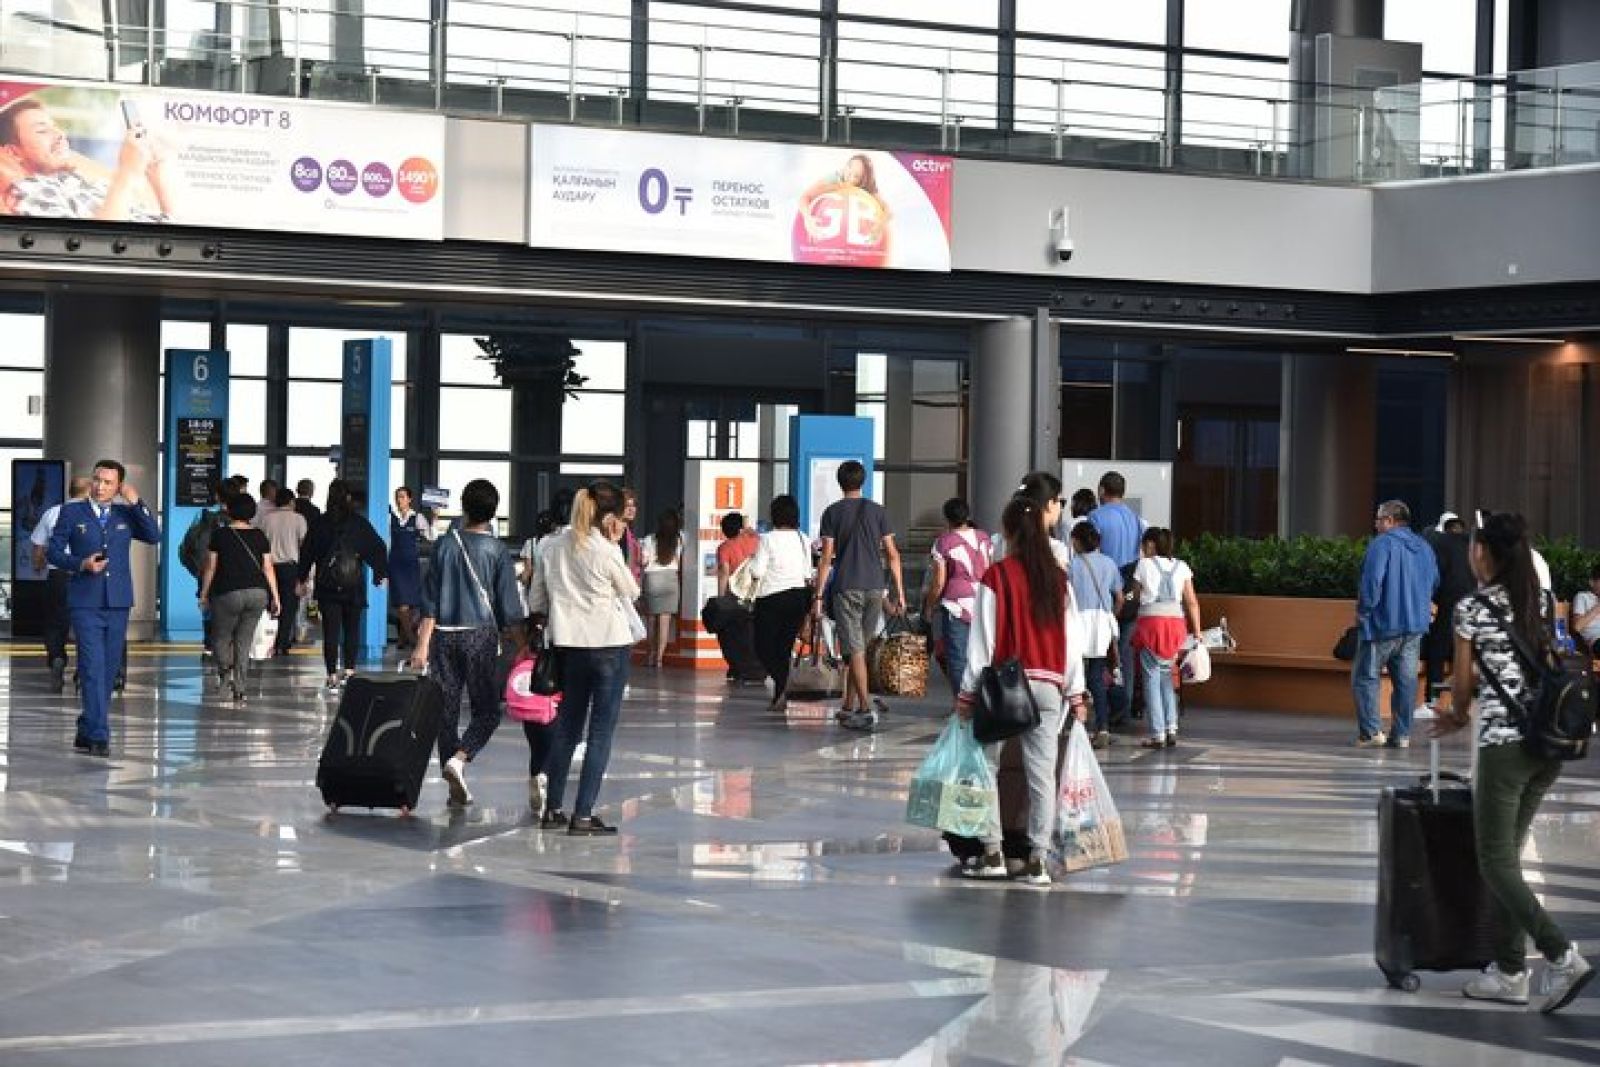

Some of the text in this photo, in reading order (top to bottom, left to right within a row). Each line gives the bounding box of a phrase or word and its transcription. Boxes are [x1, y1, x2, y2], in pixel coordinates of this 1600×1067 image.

[164, 102, 291, 129] КОМФОРТ 8
[712, 180, 765, 194] ПЕРЕНОС
[193, 356, 209, 380] 6
